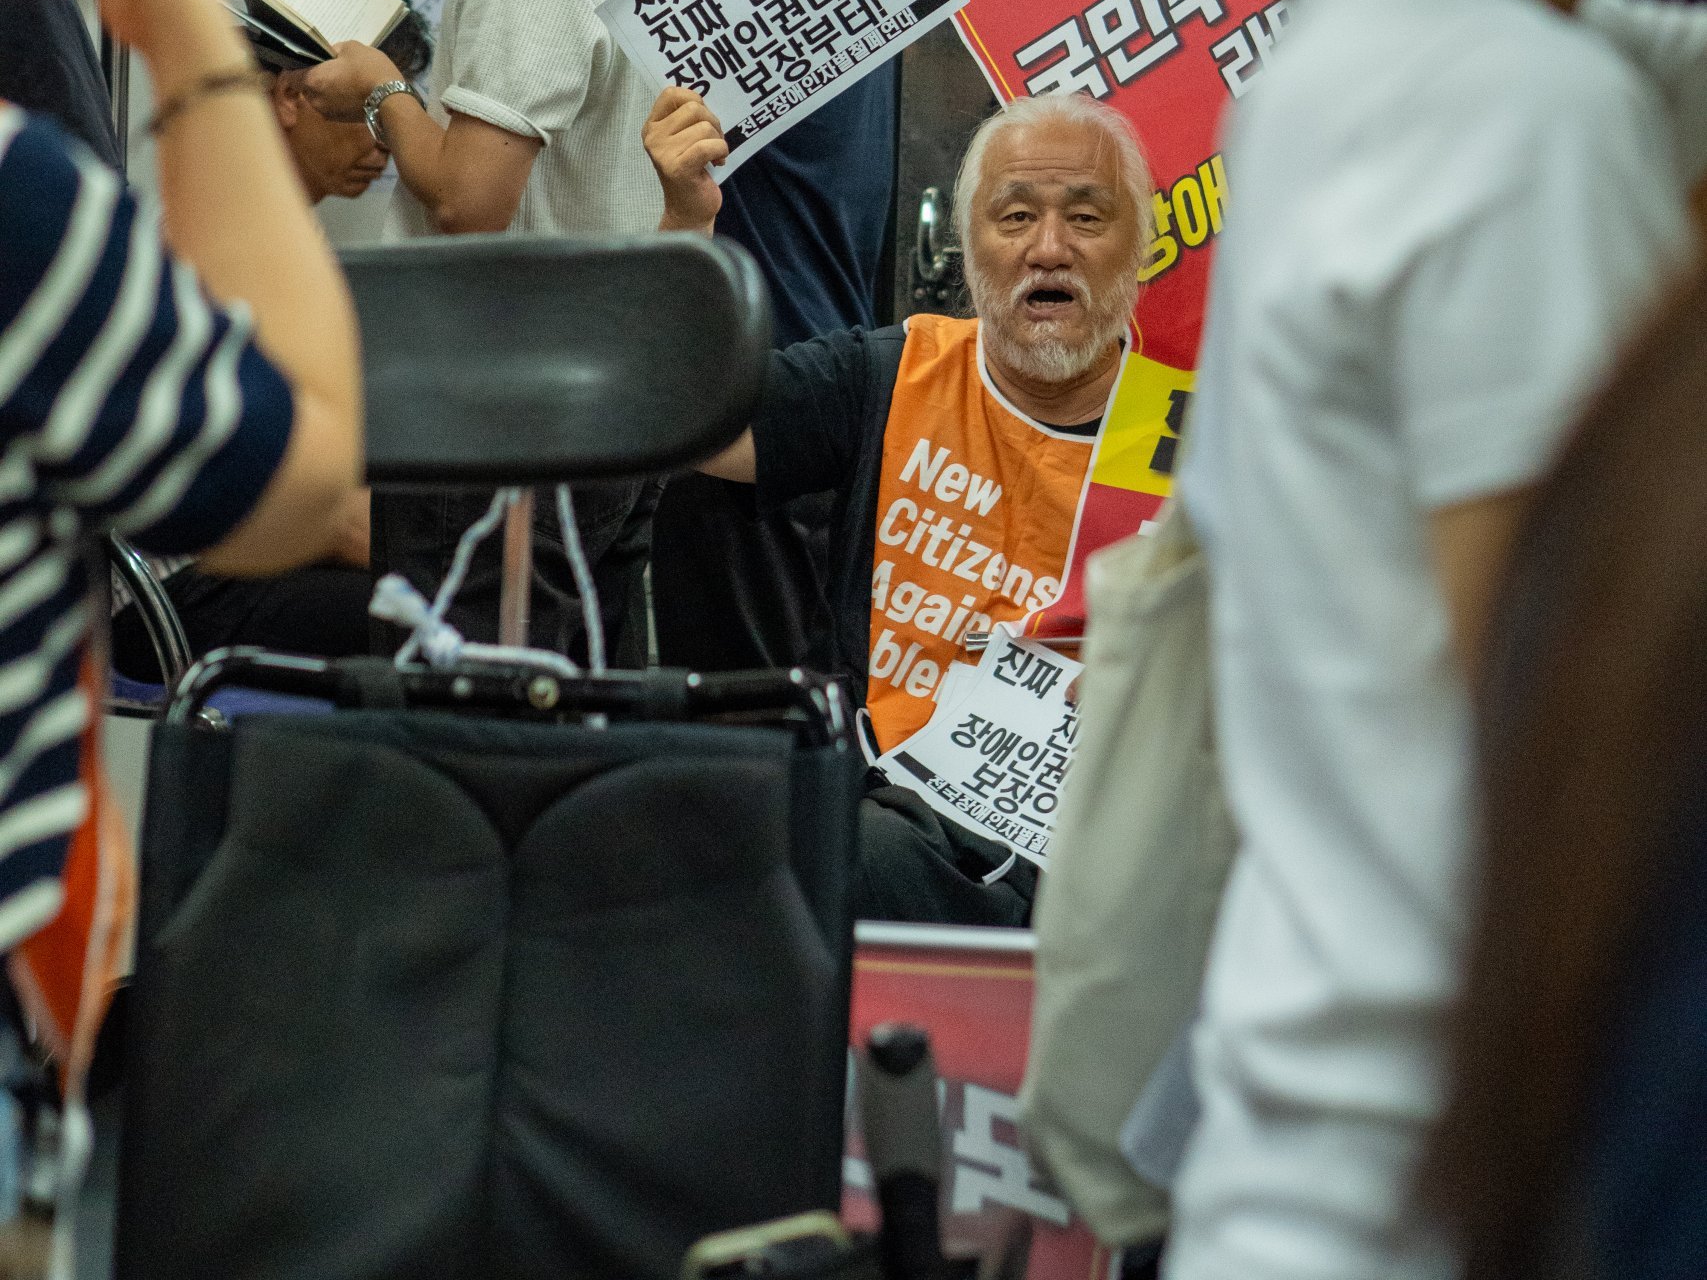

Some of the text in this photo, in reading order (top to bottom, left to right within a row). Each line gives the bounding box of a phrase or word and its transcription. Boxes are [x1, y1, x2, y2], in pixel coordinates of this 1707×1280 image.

[737, 6, 919, 138] 전국장애인차별철폐연대
[899, 438, 1002, 517] New
[878, 497, 1061, 612] Citizens
[871, 559, 993, 646] Again
[993, 642, 1063, 699] 진짜
[950, 713, 1069, 791] 장애인권
[928, 775, 1051, 857] 전국장애인차별철
[961, 762, 1057, 832] 보장으
